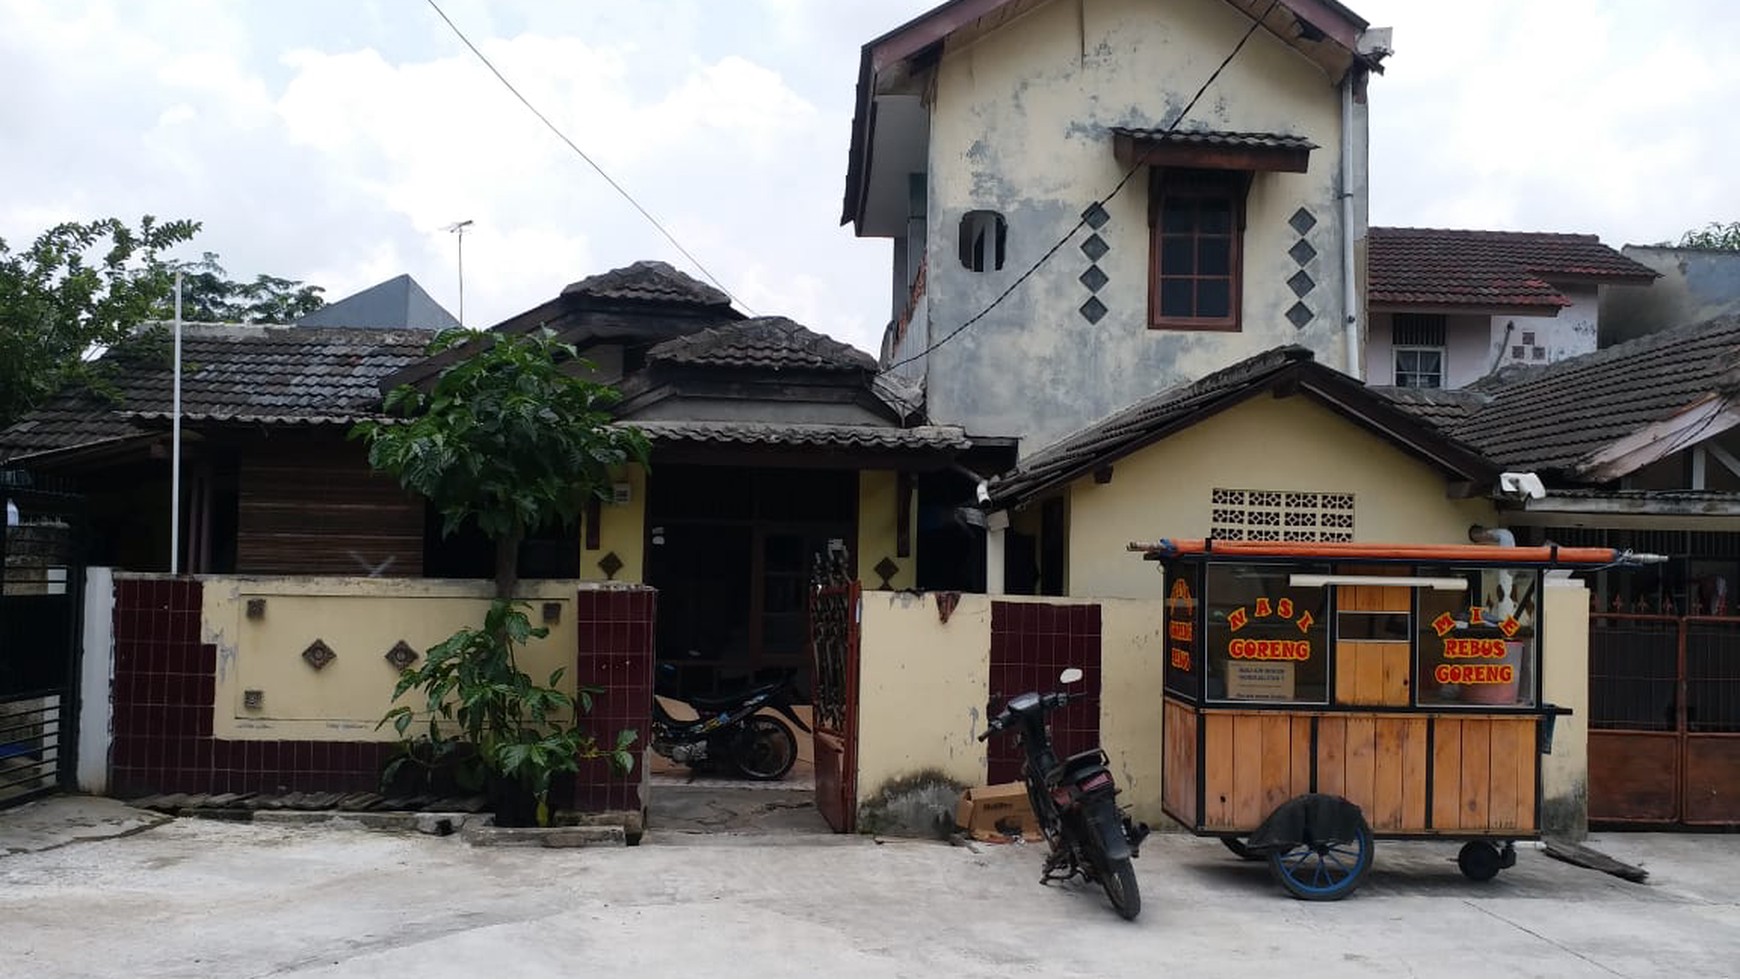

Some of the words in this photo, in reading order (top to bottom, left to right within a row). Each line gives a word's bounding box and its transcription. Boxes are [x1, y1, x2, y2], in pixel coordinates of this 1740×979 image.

[1227, 597, 1314, 633] NASI
[1432, 607, 1520, 637] MIE
[1229, 639, 1310, 660] GORENG
[1444, 638, 1507, 658] REBUS
[1435, 665, 1514, 684] GORENG
